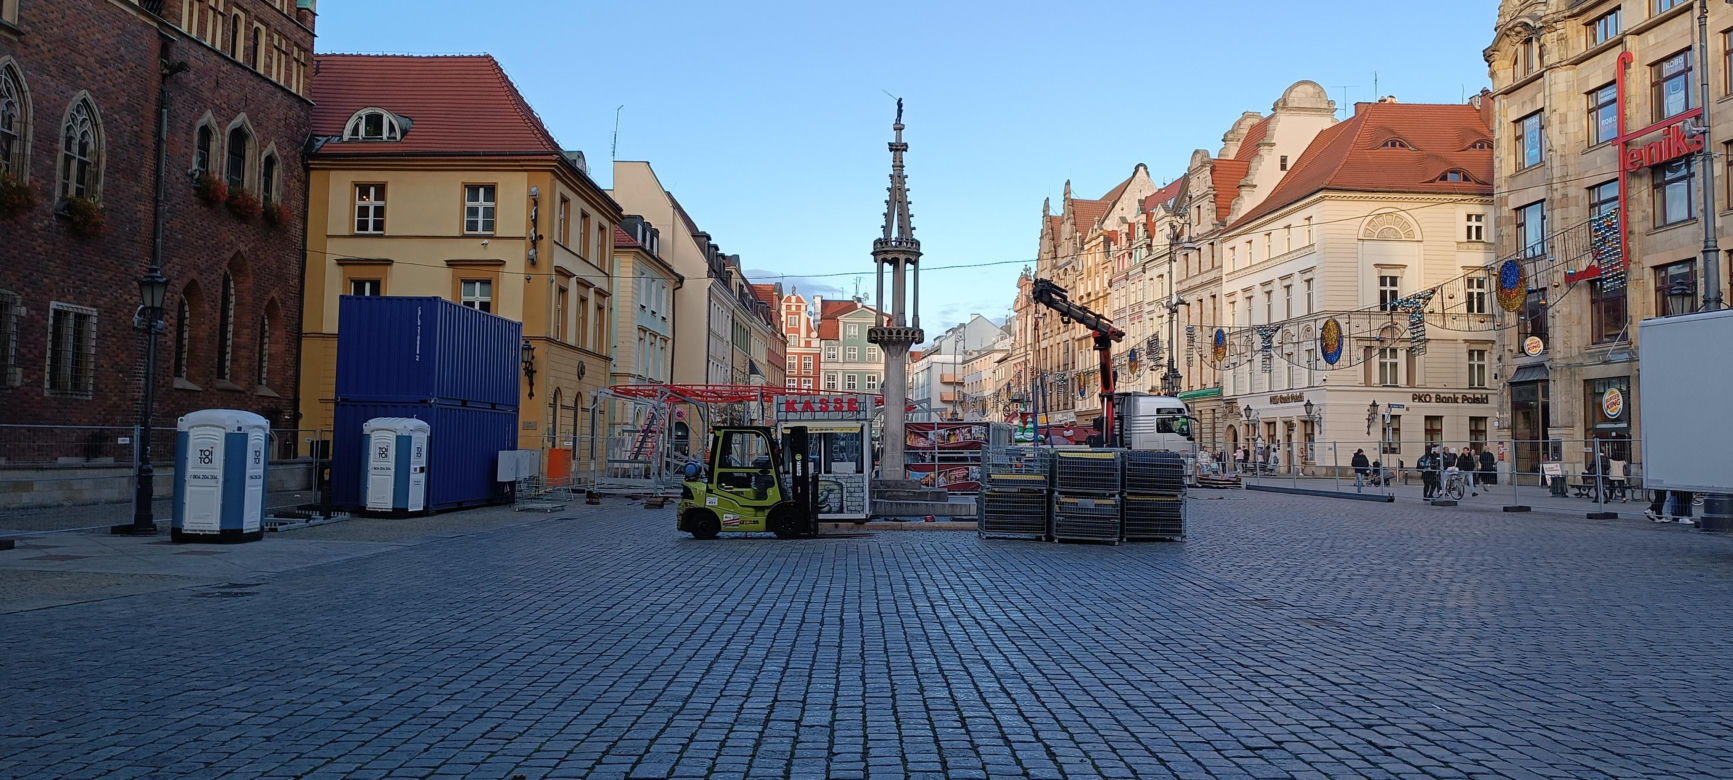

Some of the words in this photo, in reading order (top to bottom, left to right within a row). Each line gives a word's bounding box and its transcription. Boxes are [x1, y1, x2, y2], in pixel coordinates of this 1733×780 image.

[1411, 393, 1432, 403] PKO
[1435, 393, 1460, 403] Bank
[1461, 394, 1489, 404] Polski
[785, 397, 858, 416] KASSE
[198, 456, 213, 465] TOI
